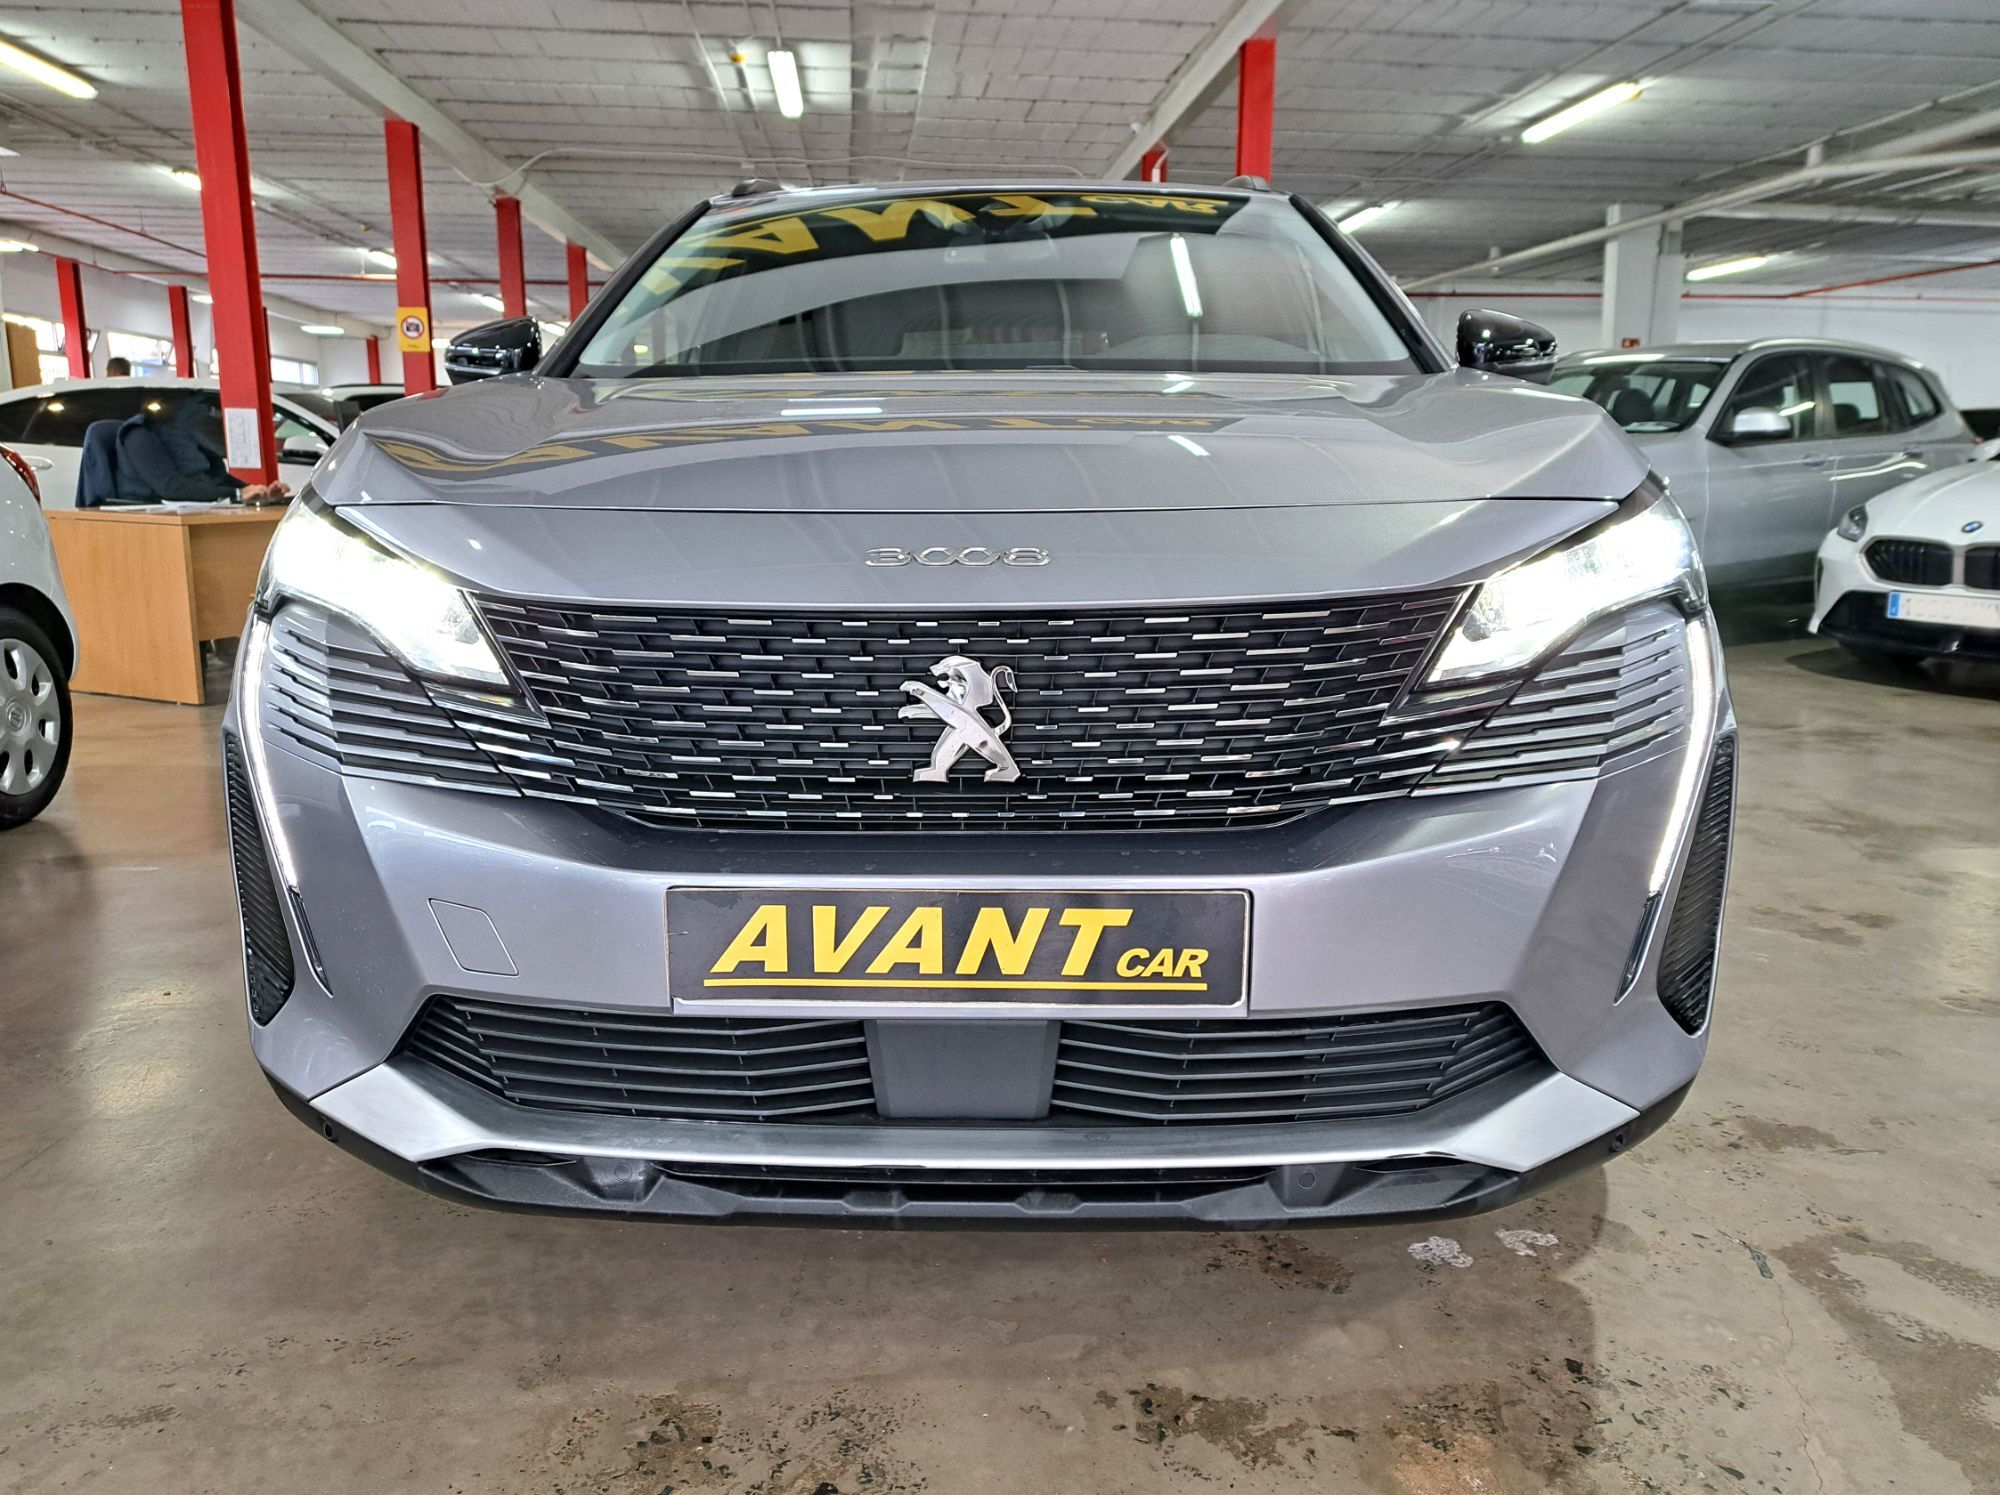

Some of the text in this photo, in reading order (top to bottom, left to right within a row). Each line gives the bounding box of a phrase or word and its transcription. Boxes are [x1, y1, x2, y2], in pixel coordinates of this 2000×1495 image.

[864, 547, 1050, 568] 3008
[711, 905, 1208, 978] AVANT CAR
